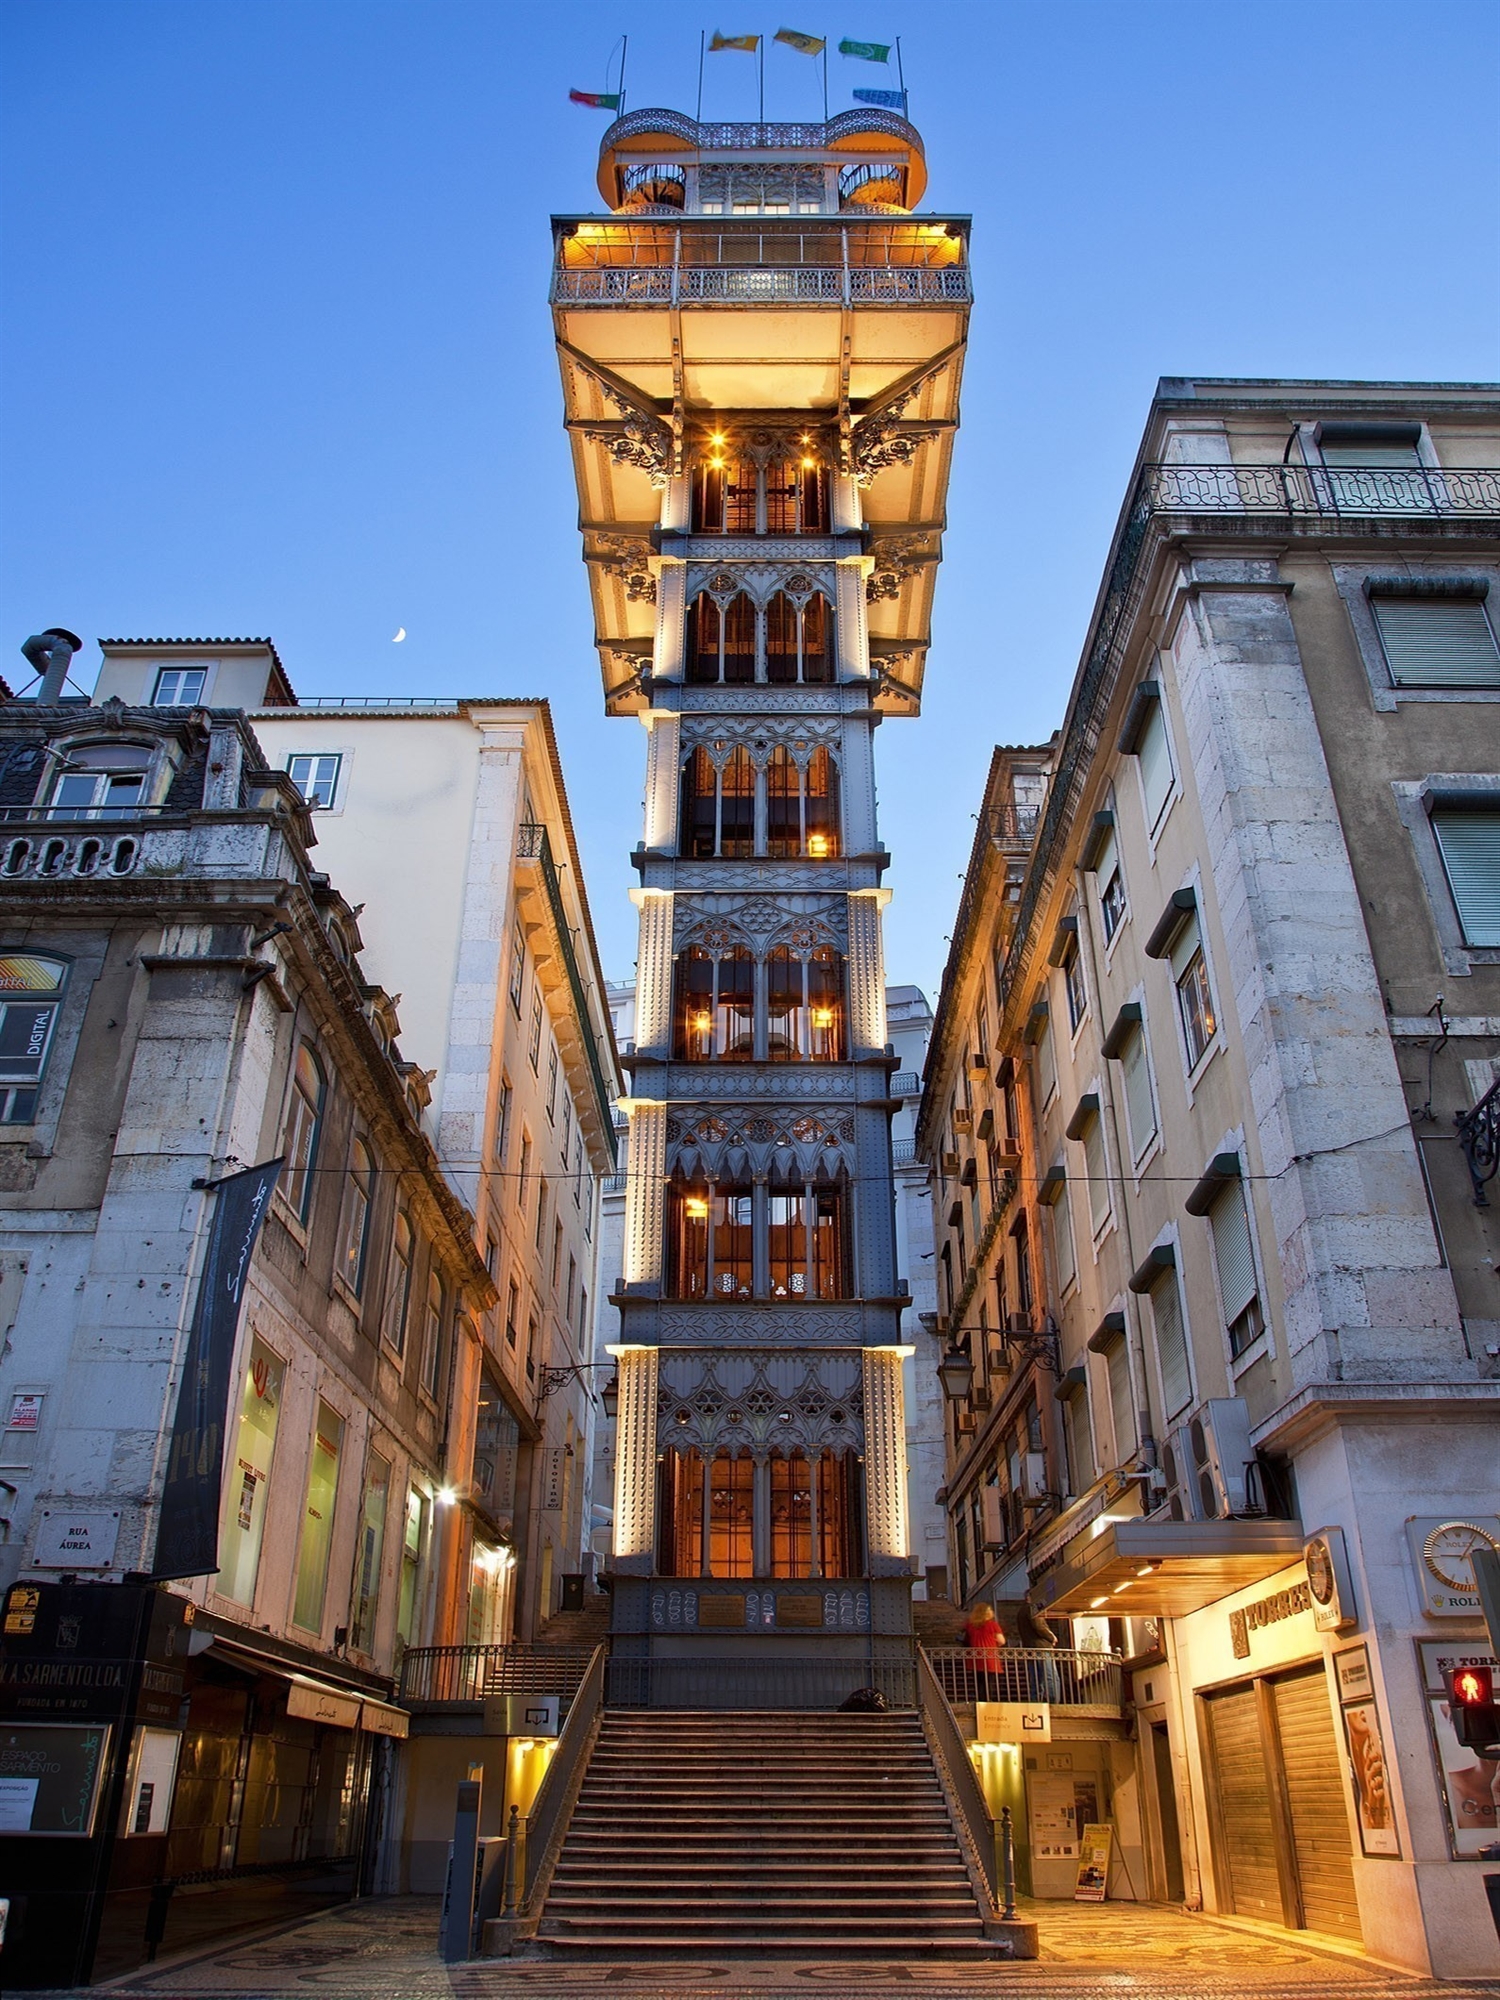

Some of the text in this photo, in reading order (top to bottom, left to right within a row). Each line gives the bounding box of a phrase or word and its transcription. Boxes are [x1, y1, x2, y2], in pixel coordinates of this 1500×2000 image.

[27, 1010, 50, 1055] DIGITAL
[227, 1178, 267, 1303] Sarmento
[69, 1528, 88, 1536] RUA
[59, 1539, 91, 1549] ÁUREA
[1245, 1580, 1313, 1631] TORRES
[1320, 1609, 1335, 1622] ROLEX
[1, 1750, 47, 1762] ESPAÇO
[0, 1761, 61, 1773] SARMENTO
